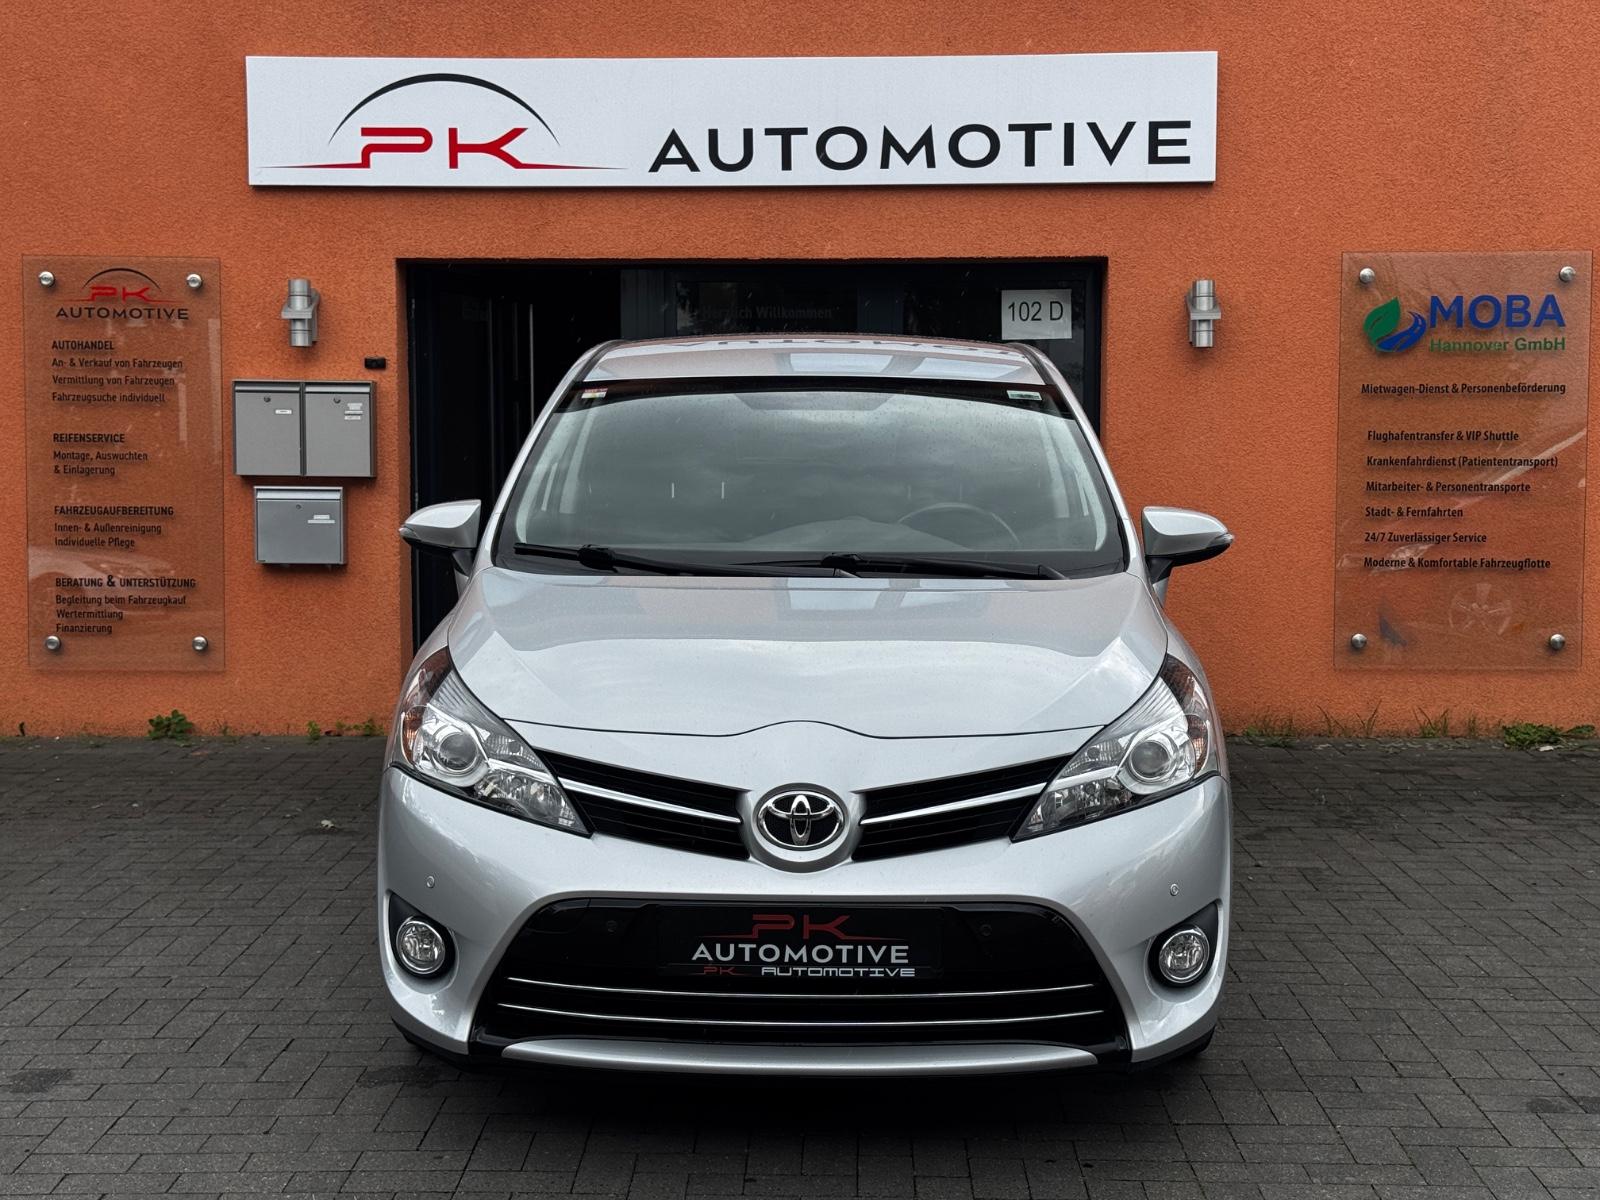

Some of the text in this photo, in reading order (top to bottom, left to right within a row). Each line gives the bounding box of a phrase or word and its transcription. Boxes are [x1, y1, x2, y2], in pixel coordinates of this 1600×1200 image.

[360, 127, 528, 169] PK
[649, 120, 1192, 173] AUTOMOTIVE
[89, 285, 151, 303] PK
[56, 307, 189, 319] AUTOMOTIVE
[1008, 303, 1063, 322] 102 D
[1430, 294, 1566, 328] MOBA
[52, 341, 114, 350] AUTOHANDEL
[1430, 337, 1565, 351] Hannover GmbH
[52, 359, 66, 367] An-
[70, 359, 75, 367] &
[79, 358, 113, 367] Verkauf
[133, 359, 183, 370] Fahrzeugen
[53, 375, 104, 386] Vermittlung
[125, 376, 174, 386] Fahrzeugen
[1361, 382, 1566, 395] Mietwagen-Dienst & Personenbeförderung
[53, 392, 165, 402] Fahrzeugsuche individuell
[54, 434, 125, 443] REIFENSERVICE
[1368, 431, 1519, 442] Flughafentransfer & VIP Shuttle
[54, 452, 148, 461] Montage, Auswuchten
[1367, 456, 1558, 468] Krankenfahrdienst (Patiententransport)
[54, 465, 115, 476] & Einlagerung
[1366, 482, 1530, 494] Mitarbeiter- & Personentransporte
[55, 506, 174, 516] FAHRZEUGAUFBEREITUNG
[1365, 507, 1463, 517] Stadt- & Fernfahrten
[55, 523, 161, 534] Innen- & Außenreinigung
[55, 538, 135, 548] Individuelle Pflege
[1364, 532, 1487, 544] 24/7 Zuverlässiger Service
[1364, 558, 1550, 570] Moderne & Komfortable Fahrzeugflotte
[56, 575, 196, 588] BERATUNG & UNTERSTÜTZUNG
[56, 595, 186, 606] Begleitung beim Fahrzeugkauf
[57, 610, 123, 620] Wertermittlung
[56, 624, 112, 634] Finanzierung
[751, 914, 852, 941] PK
[692, 944, 909, 964] AUTOMOTIVE
[761, 967, 915, 977] AUTOMOTIVE
